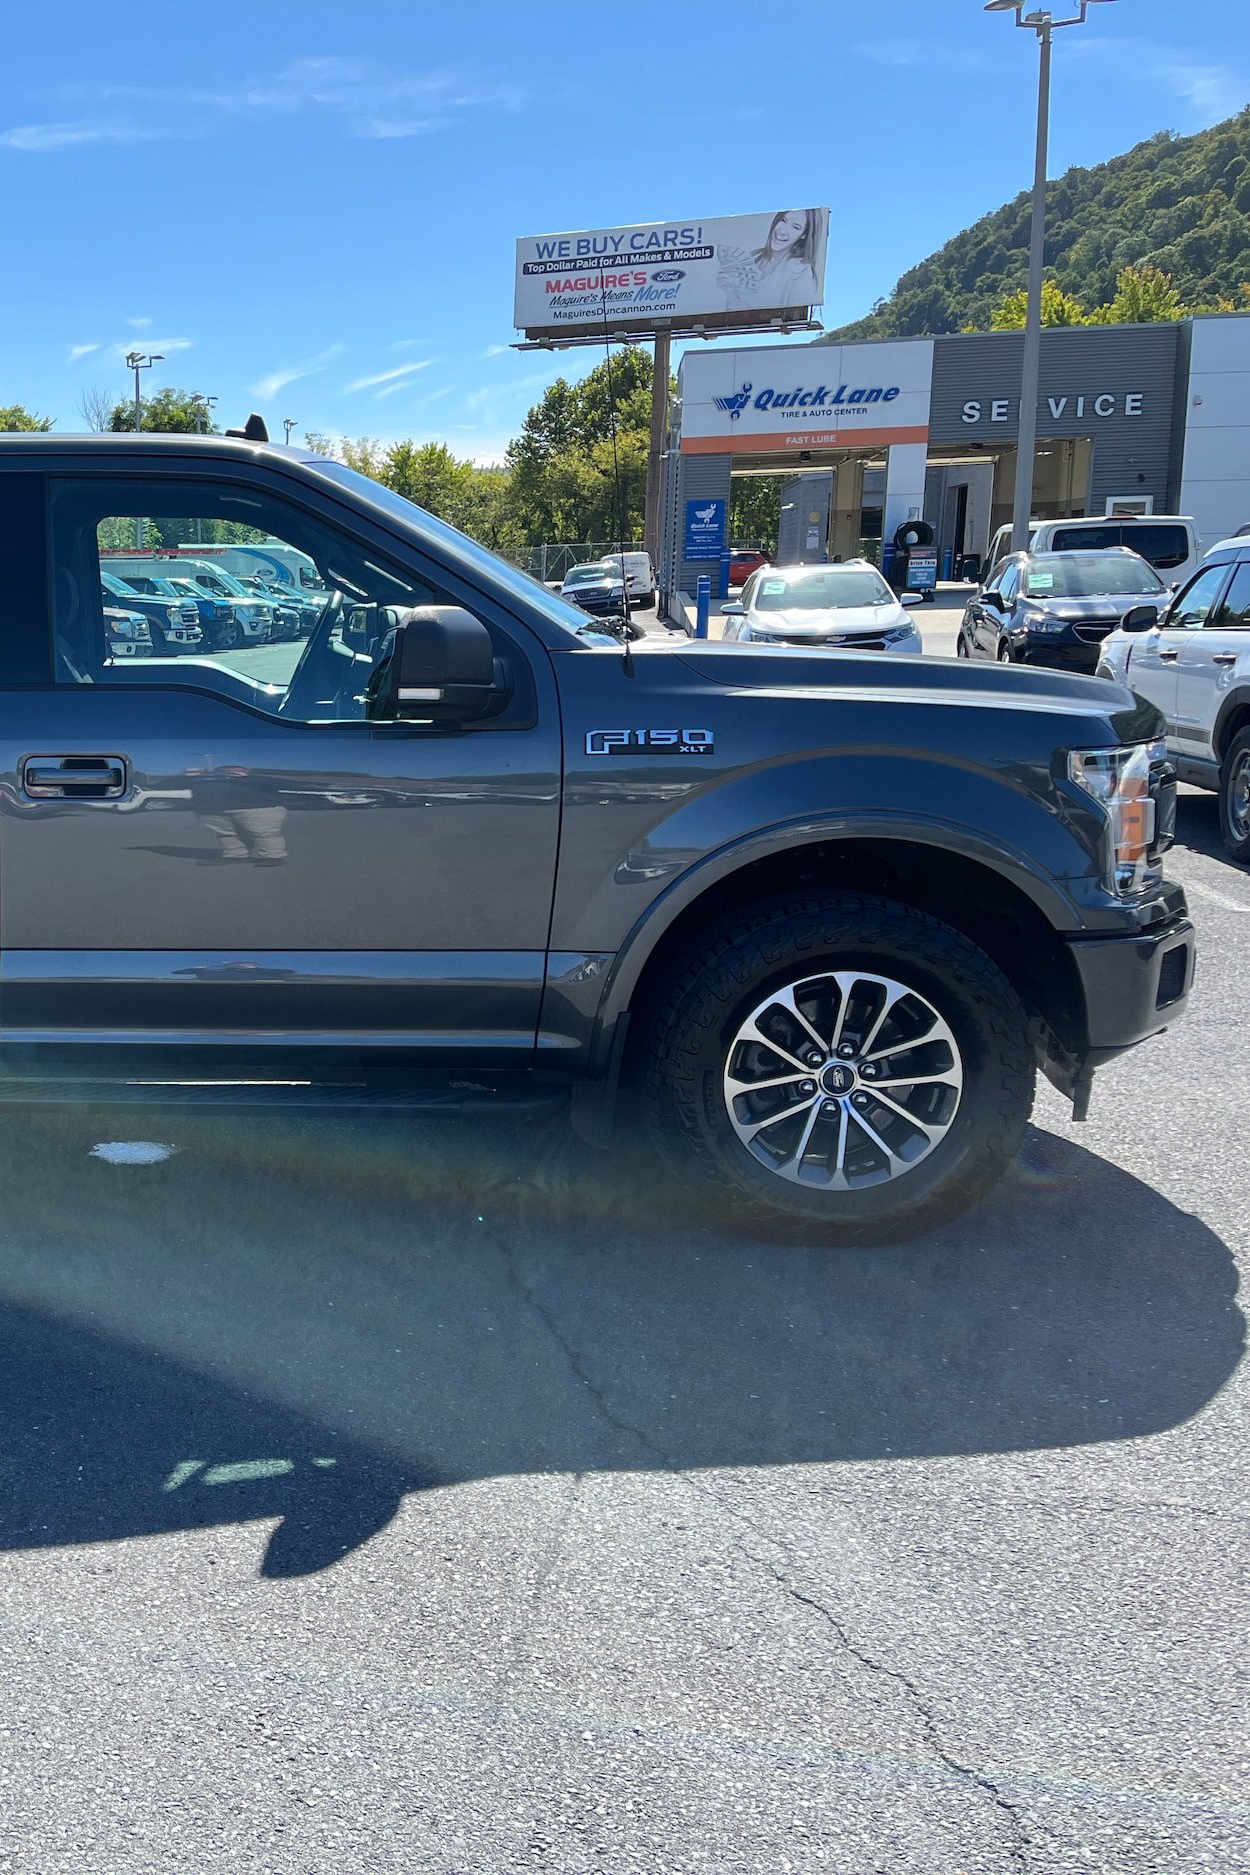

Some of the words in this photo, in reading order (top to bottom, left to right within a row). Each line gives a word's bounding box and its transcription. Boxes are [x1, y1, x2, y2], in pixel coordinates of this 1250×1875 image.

[536, 241, 570, 259] WE
[577, 234, 625, 256] BUY
[630, 227, 702, 250] CARS!
[527, 264, 545, 273] Top
[546, 261, 575, 271] Dollar
[576, 258, 598, 268] Paid
[598, 256, 613, 267] for
[615, 255, 628, 265] All
[630, 253, 662, 263] Makes
[663, 251, 672, 260] &
[673, 248, 710, 260] Models
[545, 271, 647, 293] MAGUIRE'S
[655, 270, 682, 281] Ford
[549, 293, 598, 308] Maguire's
[600, 290, 634, 301] Means
[634, 283, 681, 302] More!
[553, 303, 676, 319] MaguiresDuncannon.com
[809, 409, 832, 417] AUTO
[834, 407, 868, 415] CENTER
[961, 394, 1144, 424] SEVICE
[786, 436, 809, 445] FAST
[811, 434, 837, 444] LUBE
[679, 745, 706, 753] XLT
